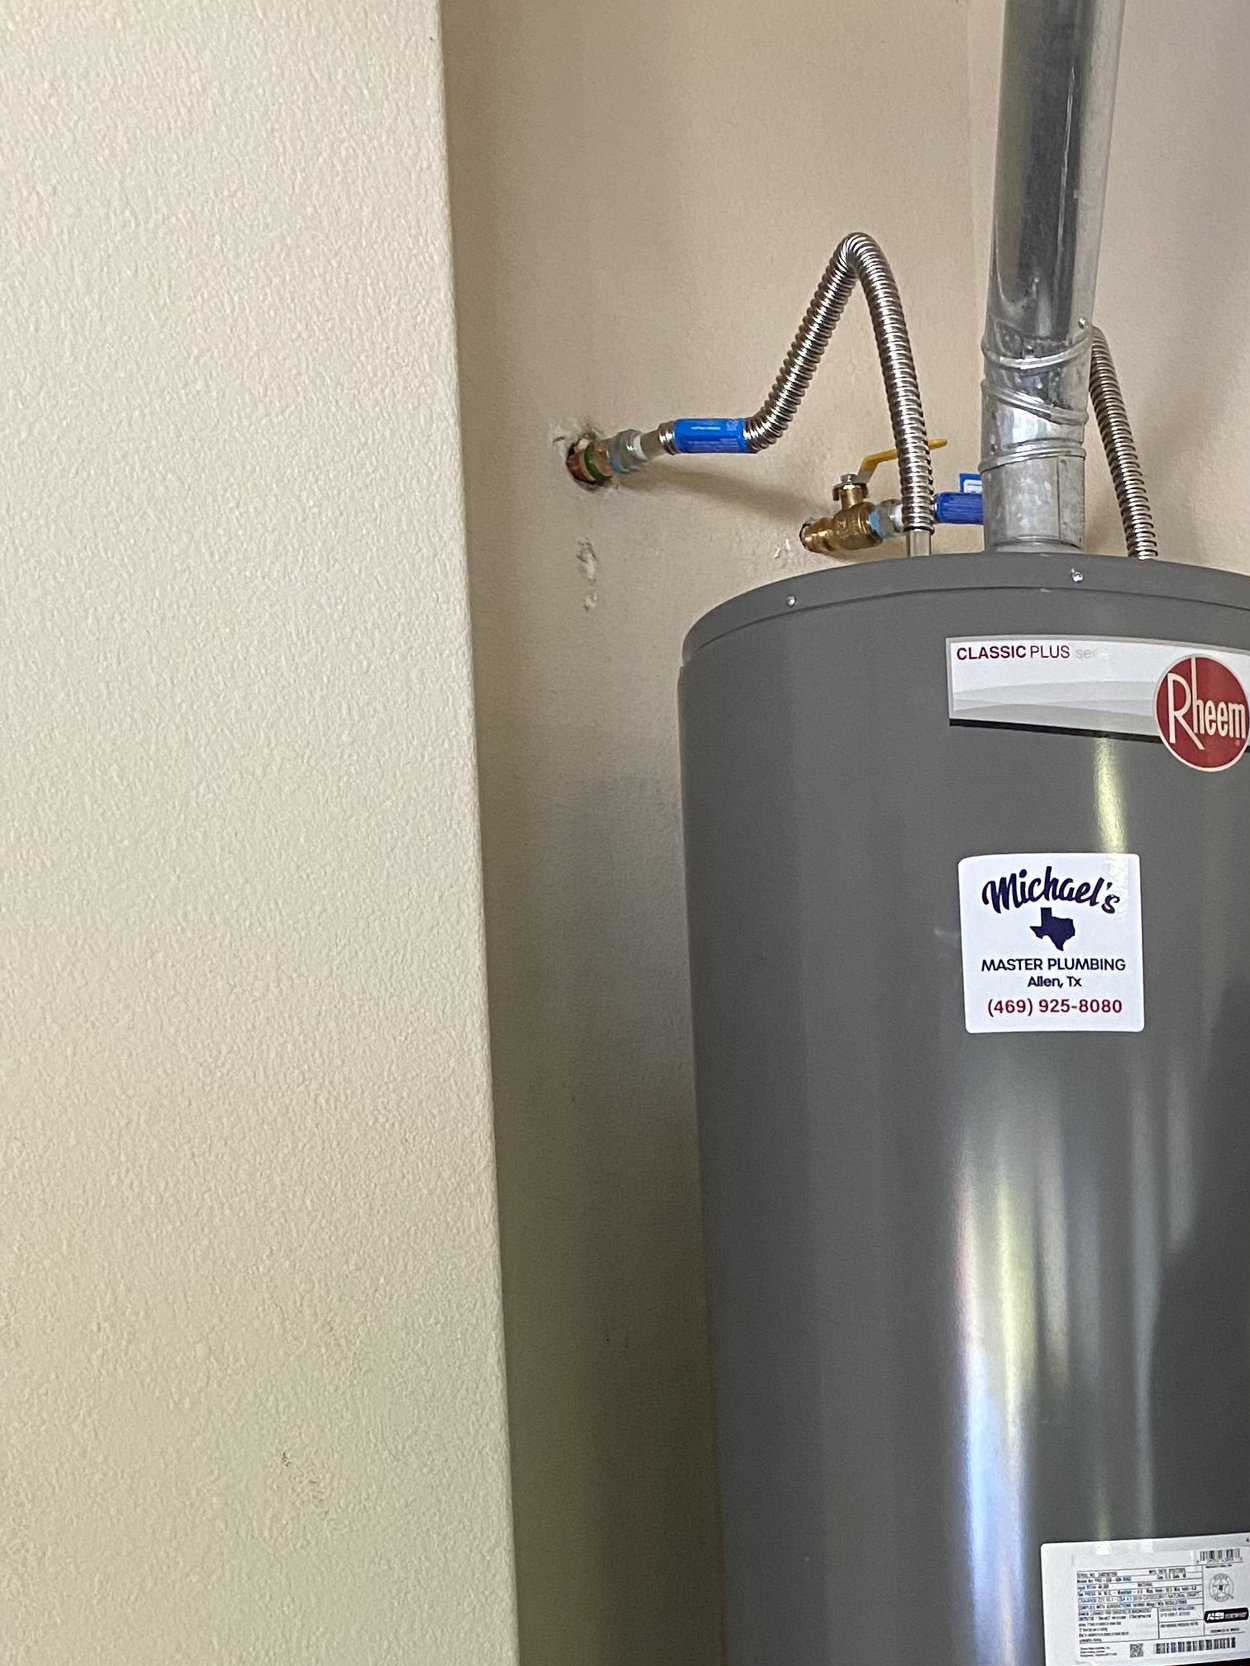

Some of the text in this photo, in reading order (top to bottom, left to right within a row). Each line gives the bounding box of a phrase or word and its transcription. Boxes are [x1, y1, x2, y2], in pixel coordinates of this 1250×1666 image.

[956, 645, 1027, 661] CLASSIC
[1030, 645, 1071, 659] PLUS
[1167, 656, 1246, 750] Rheem
[982, 865, 1120, 915] Michael's
[981, 958, 1126, 972] MASTER PLUMBING
[1027, 975, 1082, 989] Allen, Tx
[988, 997, 1123, 1018] (469) 925-8080
